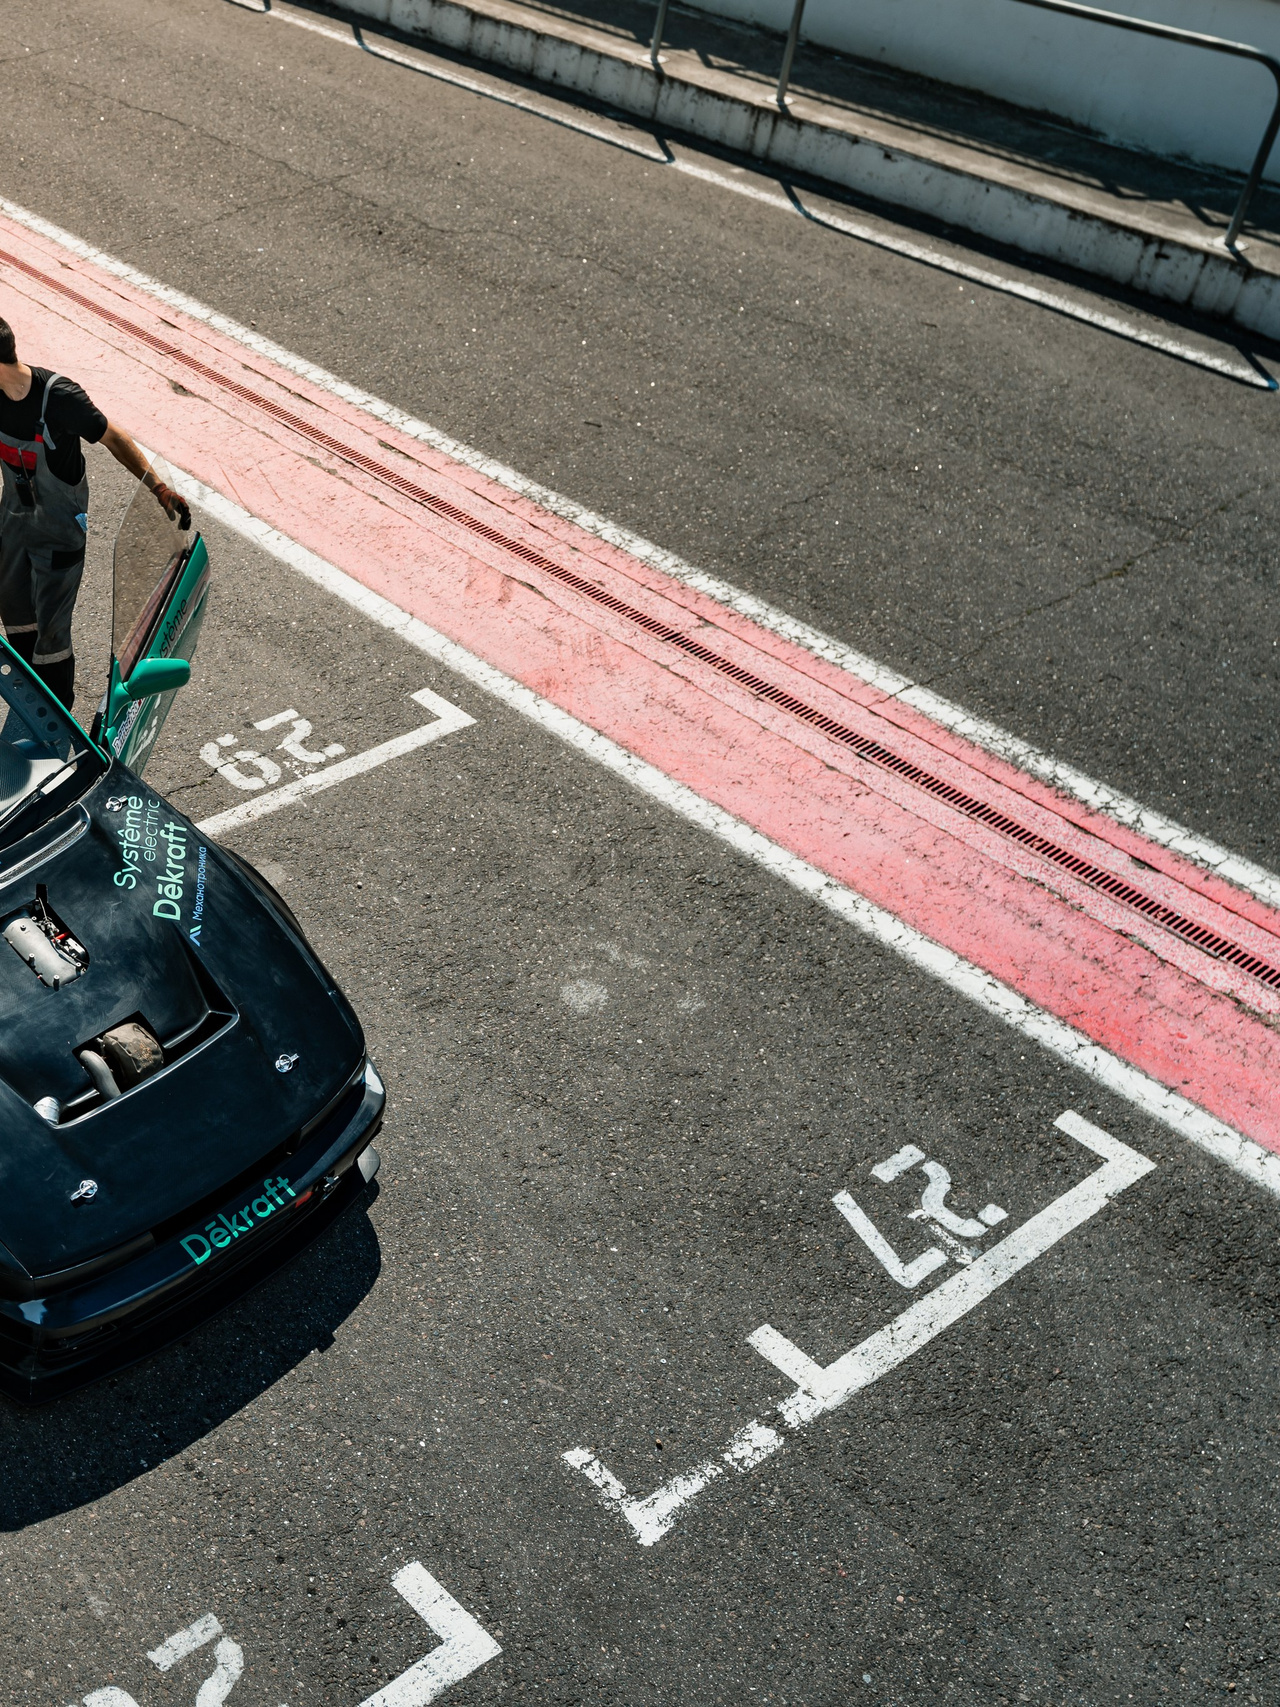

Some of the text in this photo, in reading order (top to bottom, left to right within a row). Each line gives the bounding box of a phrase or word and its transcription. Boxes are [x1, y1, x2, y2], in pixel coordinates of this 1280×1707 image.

[199, 708, 346, 790] 29
[113, 796, 143, 890] Systême
[144, 799, 160, 862] electric
[153, 821, 187, 921] Dēkraft
[192, 846, 207, 921] Механотроника
[179, 1176, 296, 1267] Dēkraft
[832, 1144, 1009, 1289] 27
